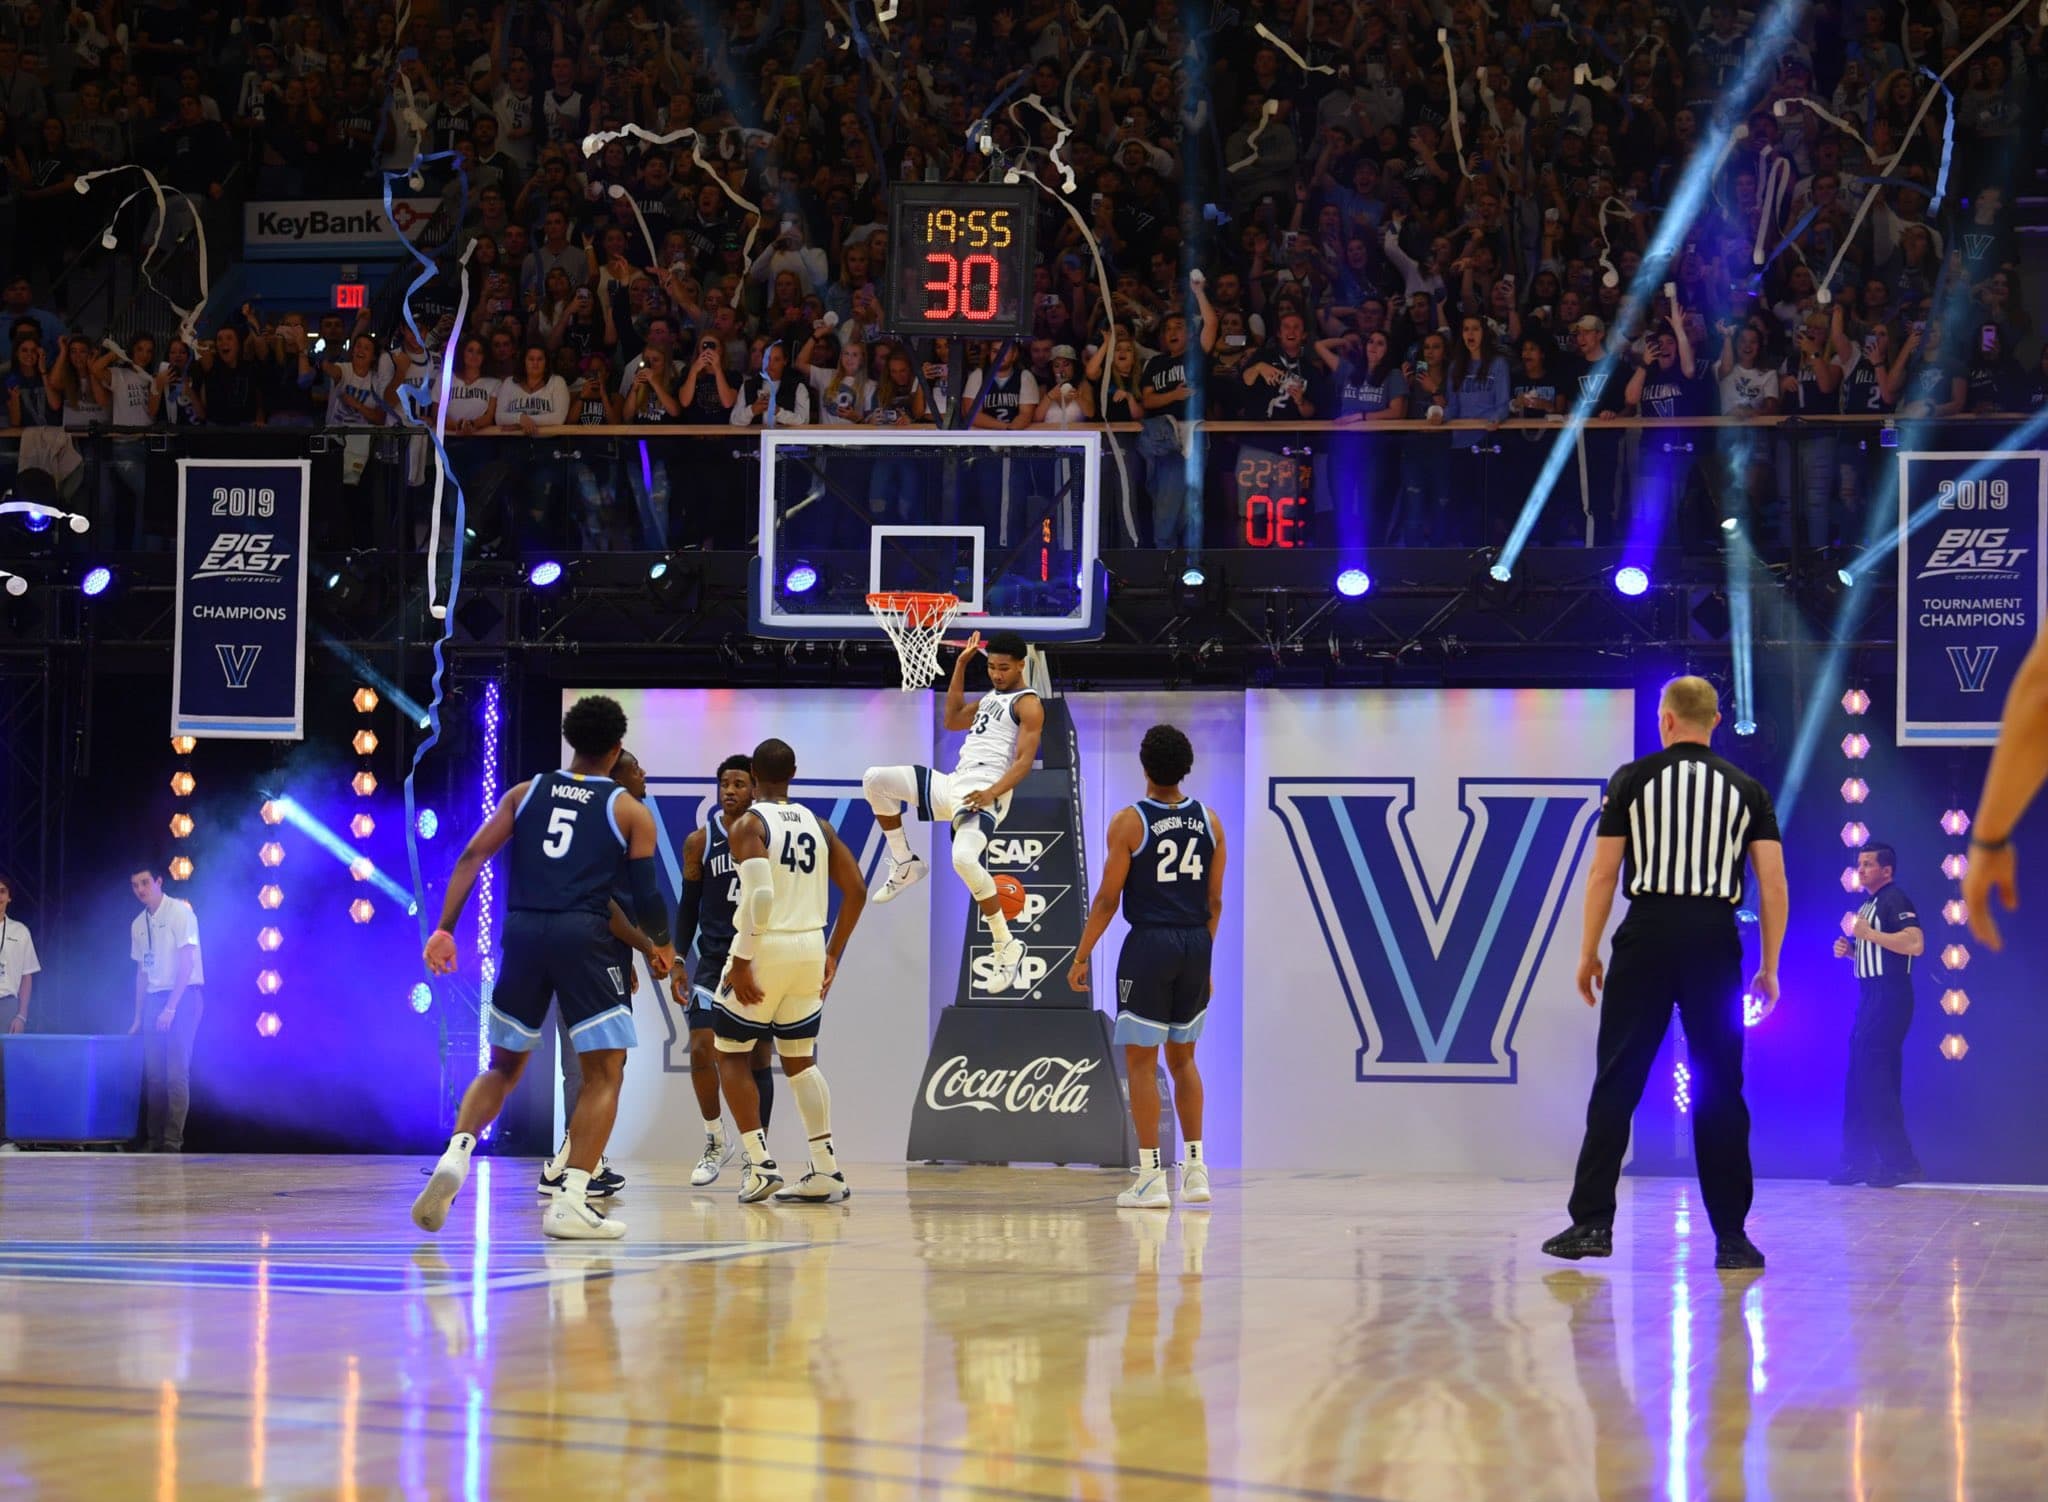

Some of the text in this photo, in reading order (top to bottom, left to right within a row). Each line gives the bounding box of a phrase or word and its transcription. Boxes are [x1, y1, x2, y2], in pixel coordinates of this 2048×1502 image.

[258, 210, 382, 239] KeyBank
[927, 210, 1011, 247] 19:55
[337, 285, 364, 308] EXIT
[924, 254, 998, 319] 30
[451, 386, 488, 401] ILLANOVA
[212, 487, 275, 517] 2019
[1937, 479, 2009, 511] 2019
[209, 533, 274, 553] BIG
[1936, 528, 2010, 549] BIG
[199, 554, 291, 571] EAST
[1925, 549, 2029, 568] EAST
[225, 576, 283, 584] CONFERENCE
[1954, 573, 2020, 581] CONFERENCE
[192, 604, 288, 621] CHAMPIONS
[1922, 598, 2022, 610] TOURNAMENT
[1919, 612, 2026, 628] CHAMPIONS
[215, 644, 262, 688] V
[1945, 646, 1999, 693] V
[551, 784, 594, 804] MOORE
[542, 807, 578, 859] 5
[780, 830, 816, 874] 43
[988, 838, 1044, 865] SAP
[1157, 837, 1204, 882] 24
[1268, 776, 1609, 1085] V
[925, 1055, 1101, 1114] Coca-Cola
